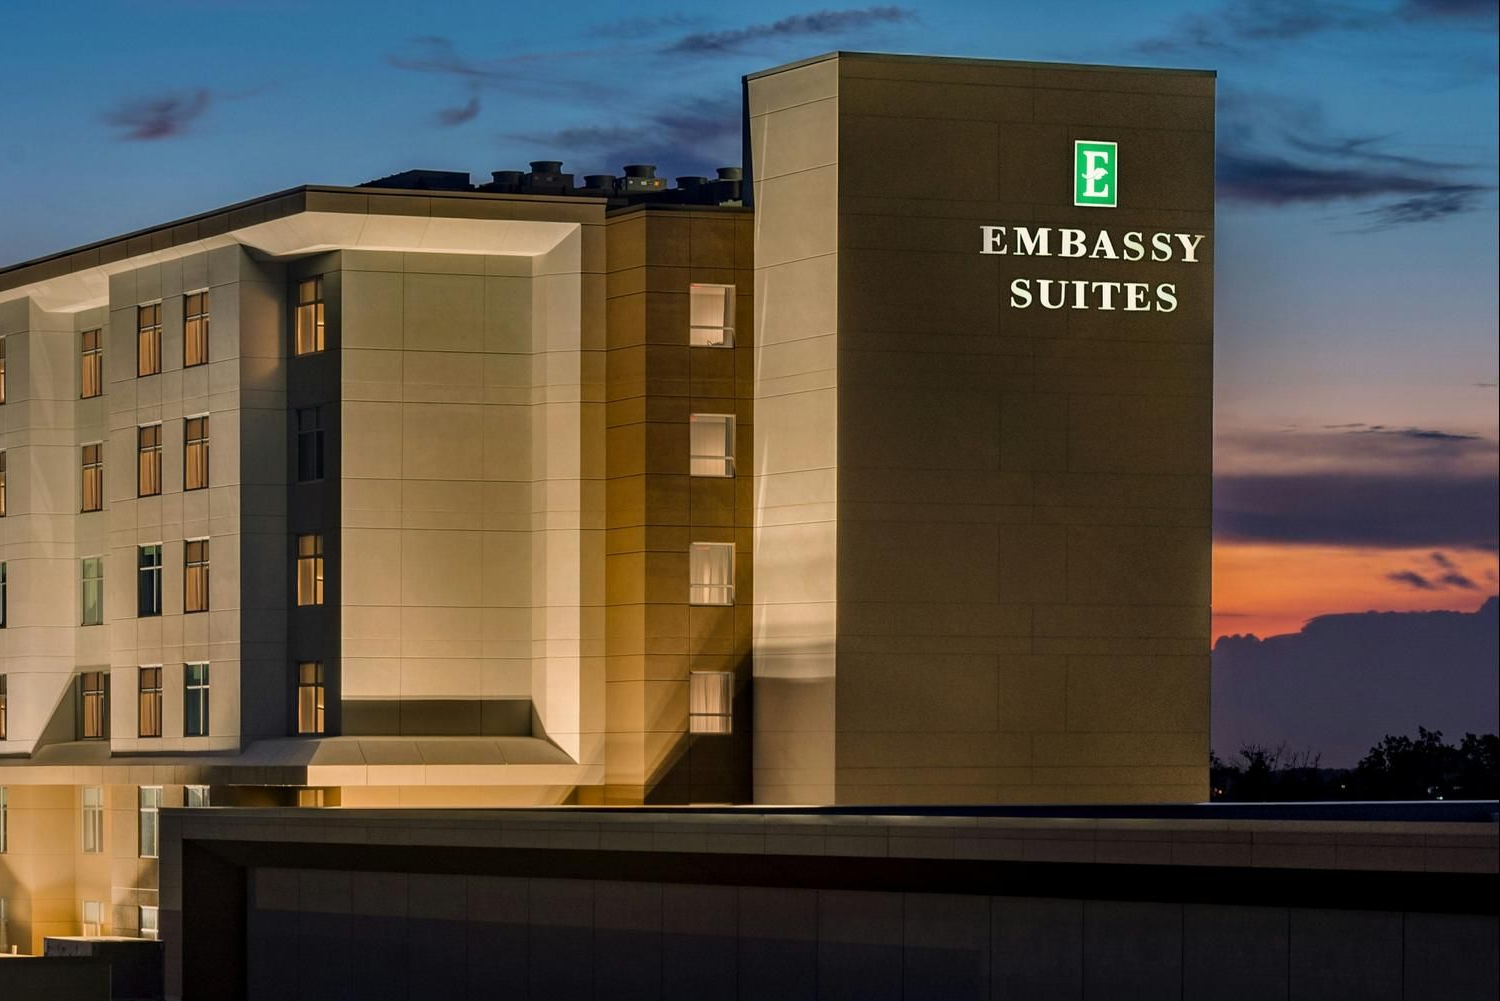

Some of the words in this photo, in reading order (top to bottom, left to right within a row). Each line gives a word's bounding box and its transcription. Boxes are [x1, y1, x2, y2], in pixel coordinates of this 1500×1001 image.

[1082, 151, 1109, 198] E
[979, 225, 1205, 262] EMBASSY
[1010, 278, 1178, 312] SUITES
